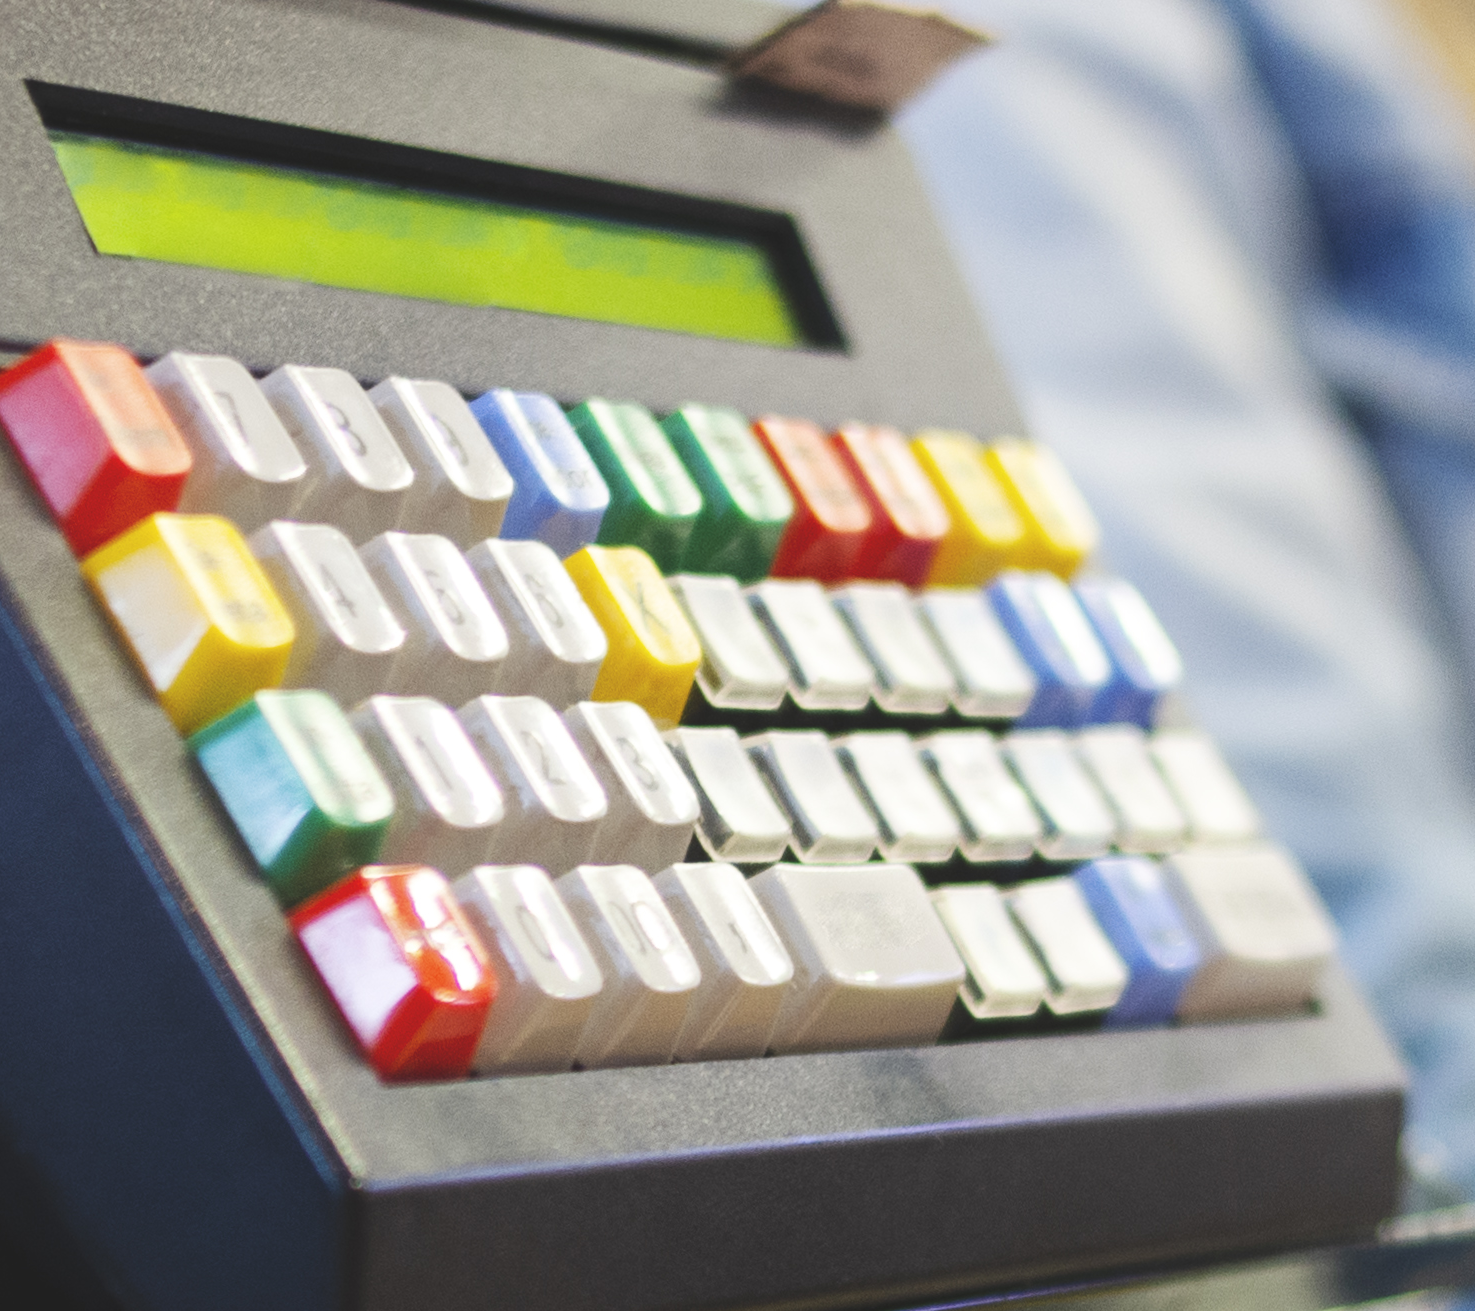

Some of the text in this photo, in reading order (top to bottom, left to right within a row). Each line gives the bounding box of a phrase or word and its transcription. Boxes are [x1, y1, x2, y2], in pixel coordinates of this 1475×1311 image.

[214, 390, 250, 448] 7
[325, 401, 367, 457] 8
[319, 562, 357, 619] 4
[414, 735, 454, 791] 1
[519, 730, 567, 786] 2
[615, 736, 660, 791] 3
